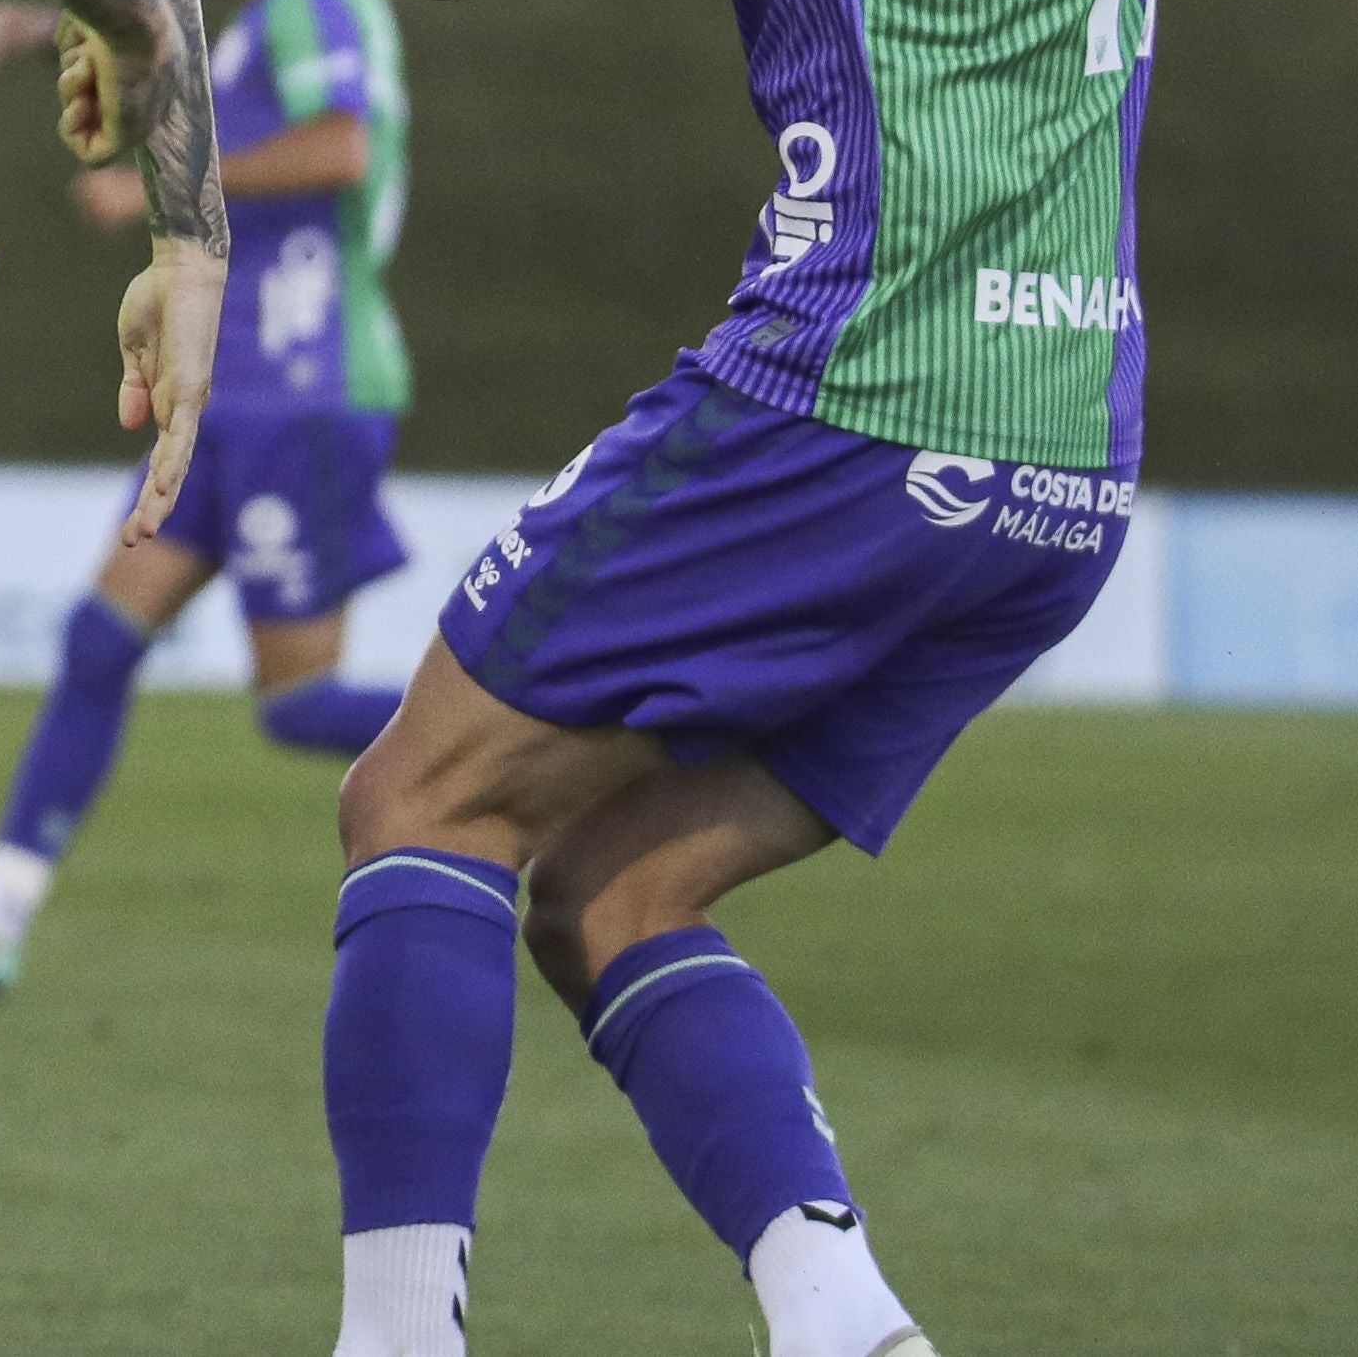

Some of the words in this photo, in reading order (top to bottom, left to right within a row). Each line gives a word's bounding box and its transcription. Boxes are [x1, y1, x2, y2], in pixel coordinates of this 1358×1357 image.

[1010, 464, 1093, 512] COSTA
[1096, 478, 1135, 518] DE
[991, 504, 1104, 554] MÁLAGA
